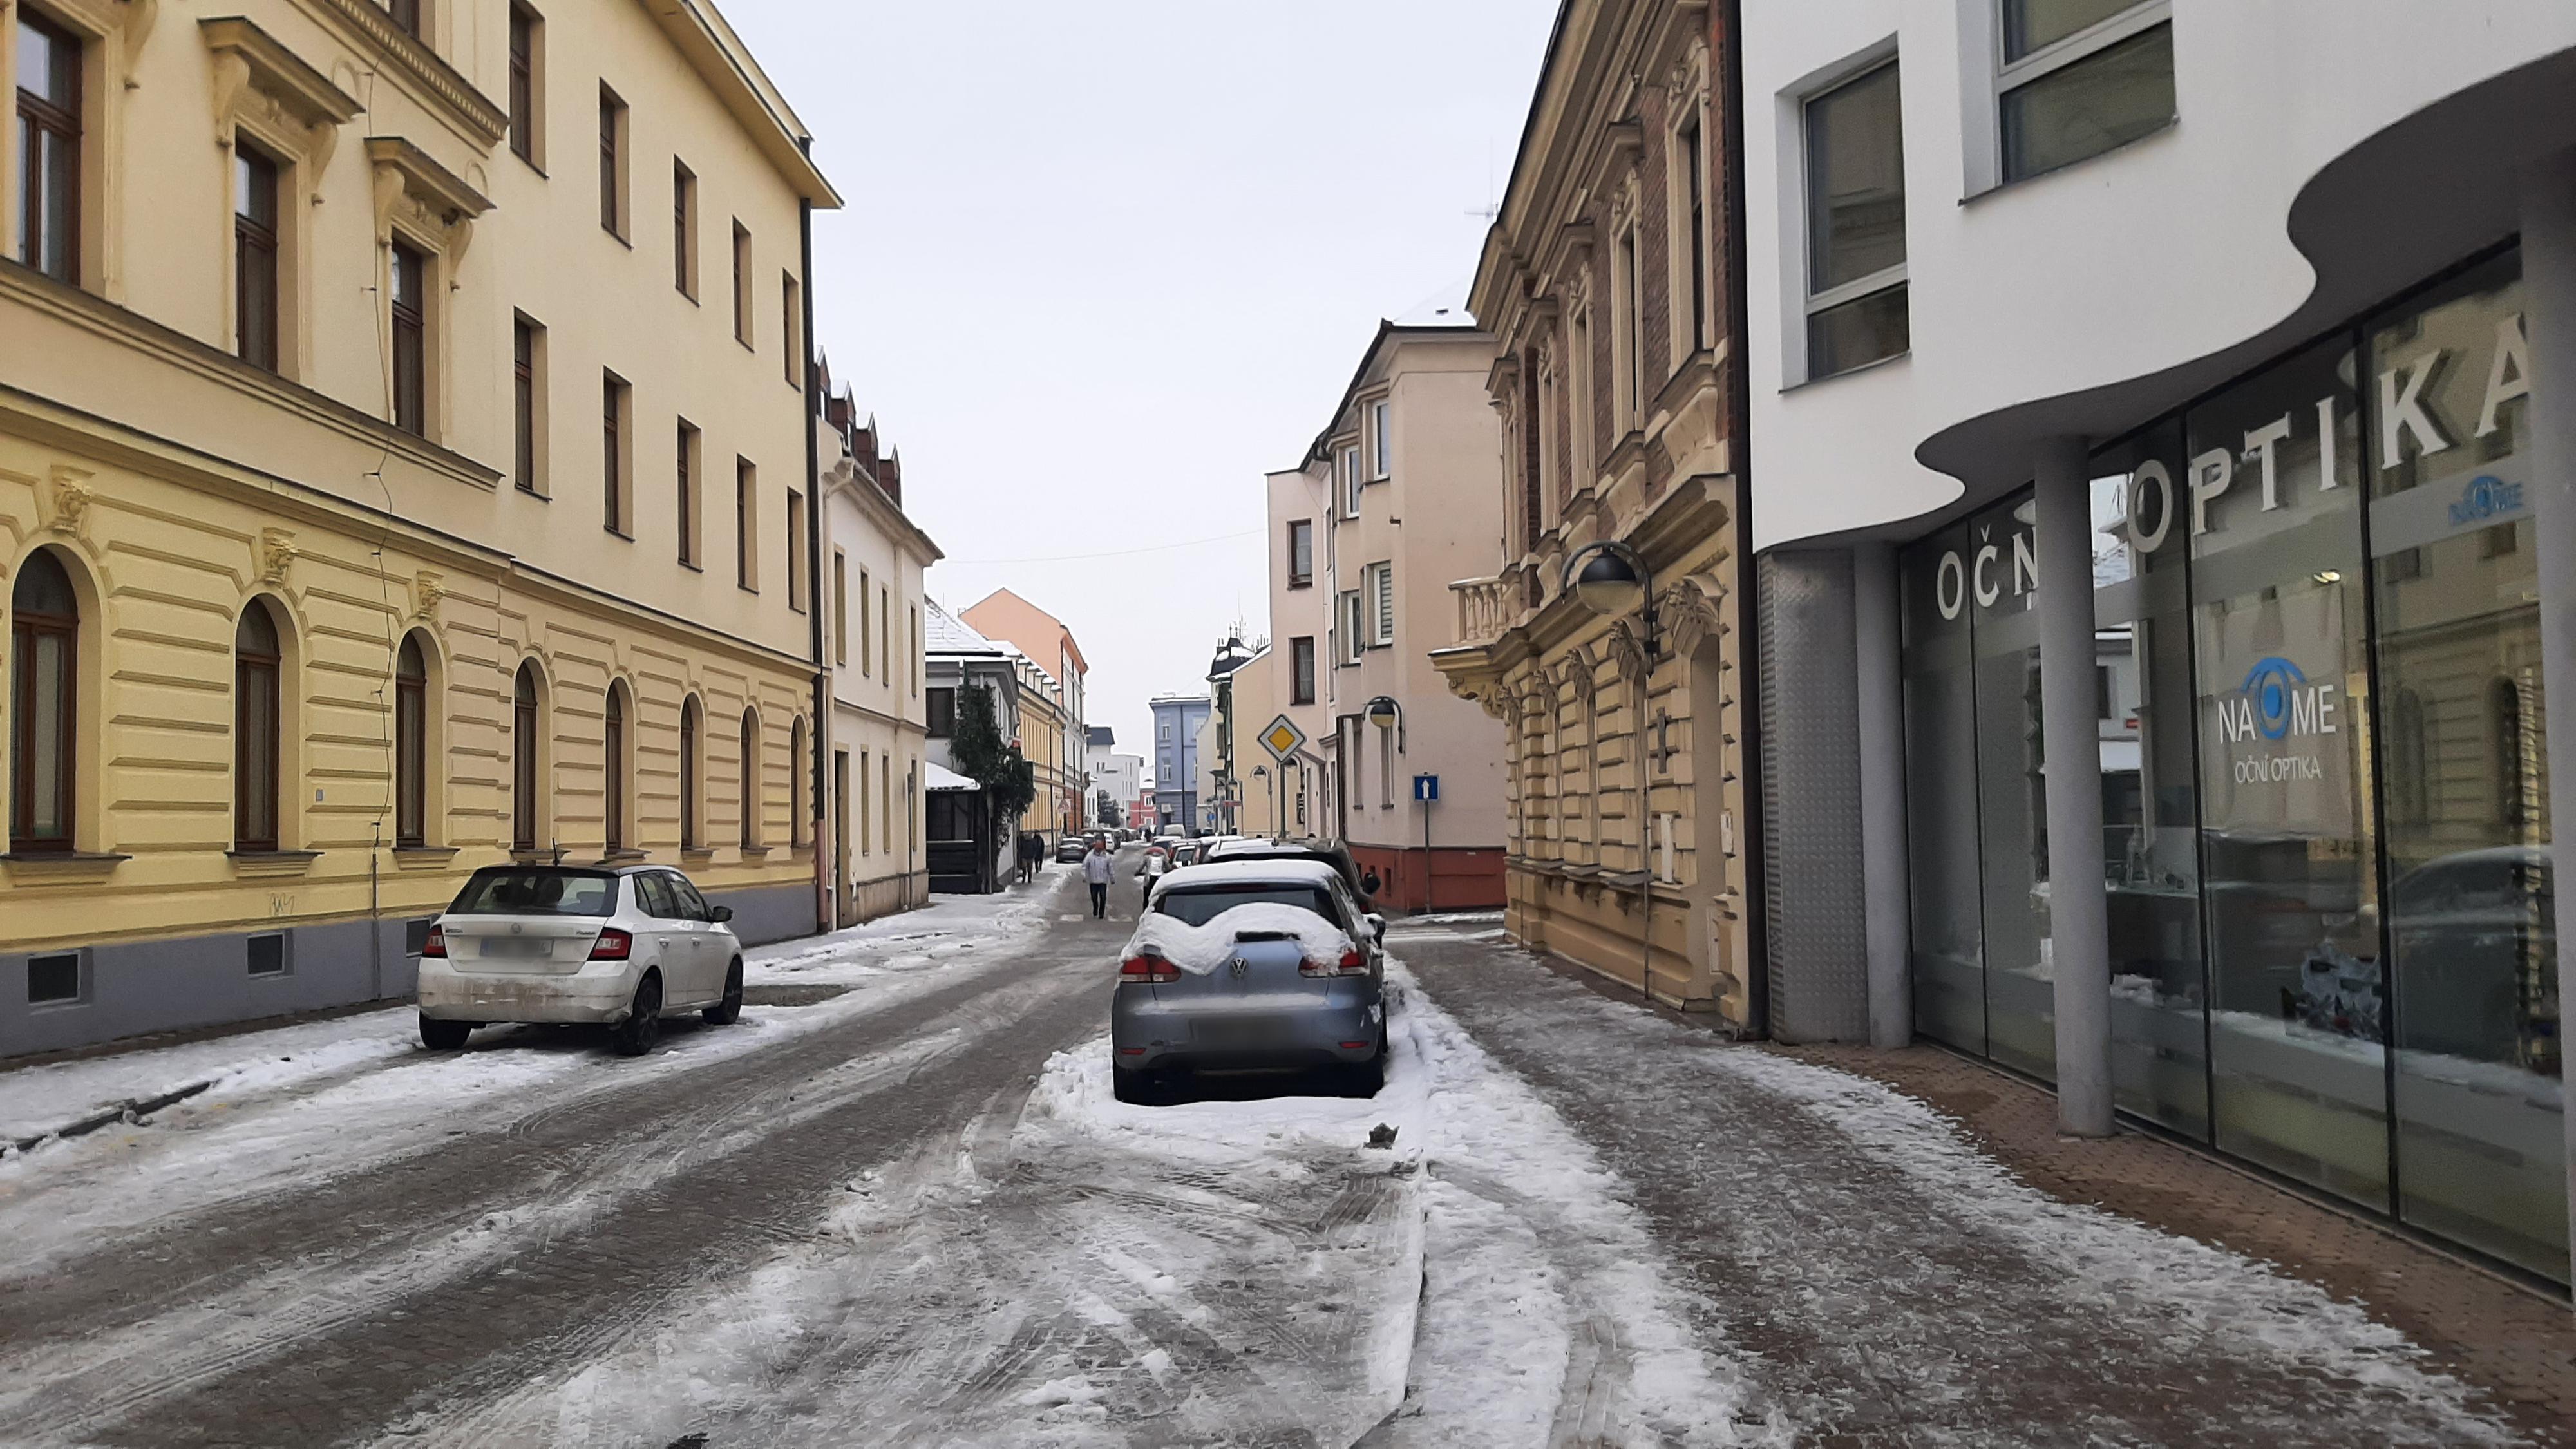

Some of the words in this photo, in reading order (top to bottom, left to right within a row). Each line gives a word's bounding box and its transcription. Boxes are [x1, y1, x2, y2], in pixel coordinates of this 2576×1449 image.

[1937, 524, 2039, 620] OČN
[2126, 312, 2530, 553] OPTIKA
[2235, 755, 2268, 784] OČNÍ
[2271, 756, 2322, 782] OPTIKA
